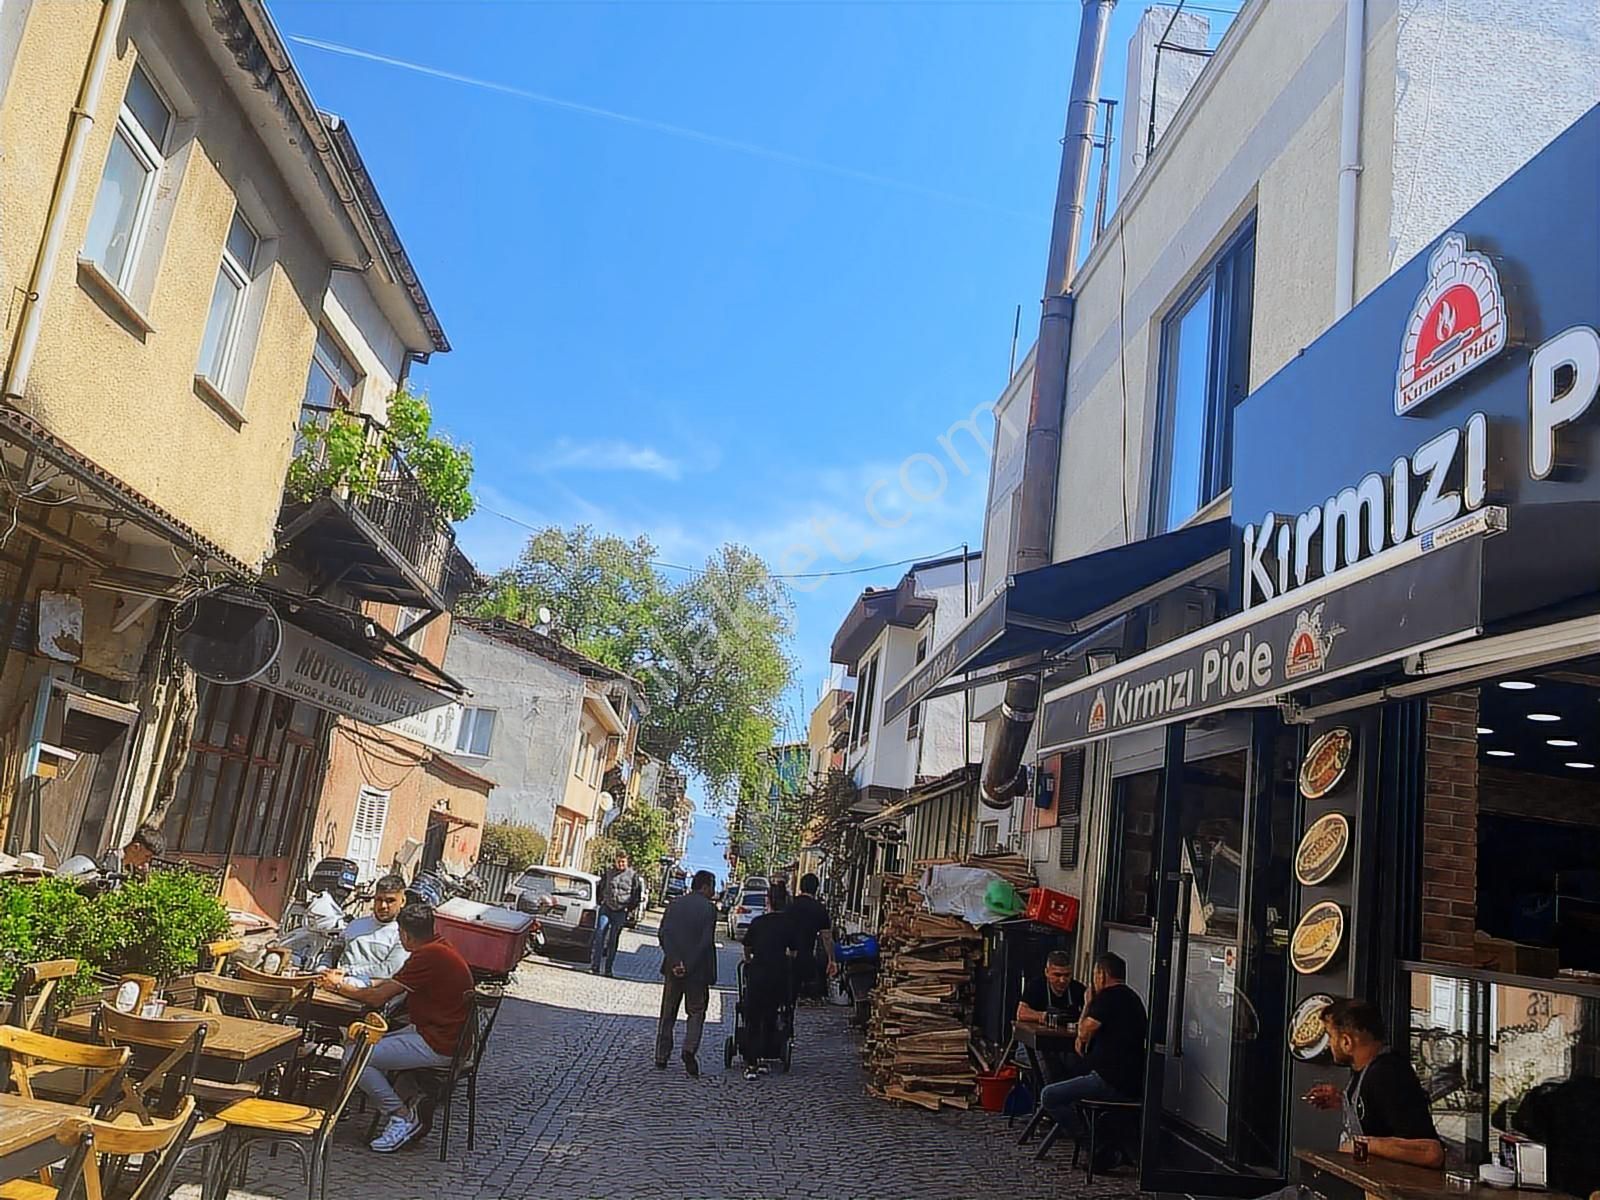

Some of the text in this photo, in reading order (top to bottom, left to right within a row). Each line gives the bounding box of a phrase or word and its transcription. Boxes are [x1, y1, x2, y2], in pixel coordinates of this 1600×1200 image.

[1463, 333, 1498, 368] Pide
[1242, 411, 1488, 611] Kırmızı
[285, 680, 318, 699] MOTOR
[1112, 632, 1273, 727] Kırmızı Pide
